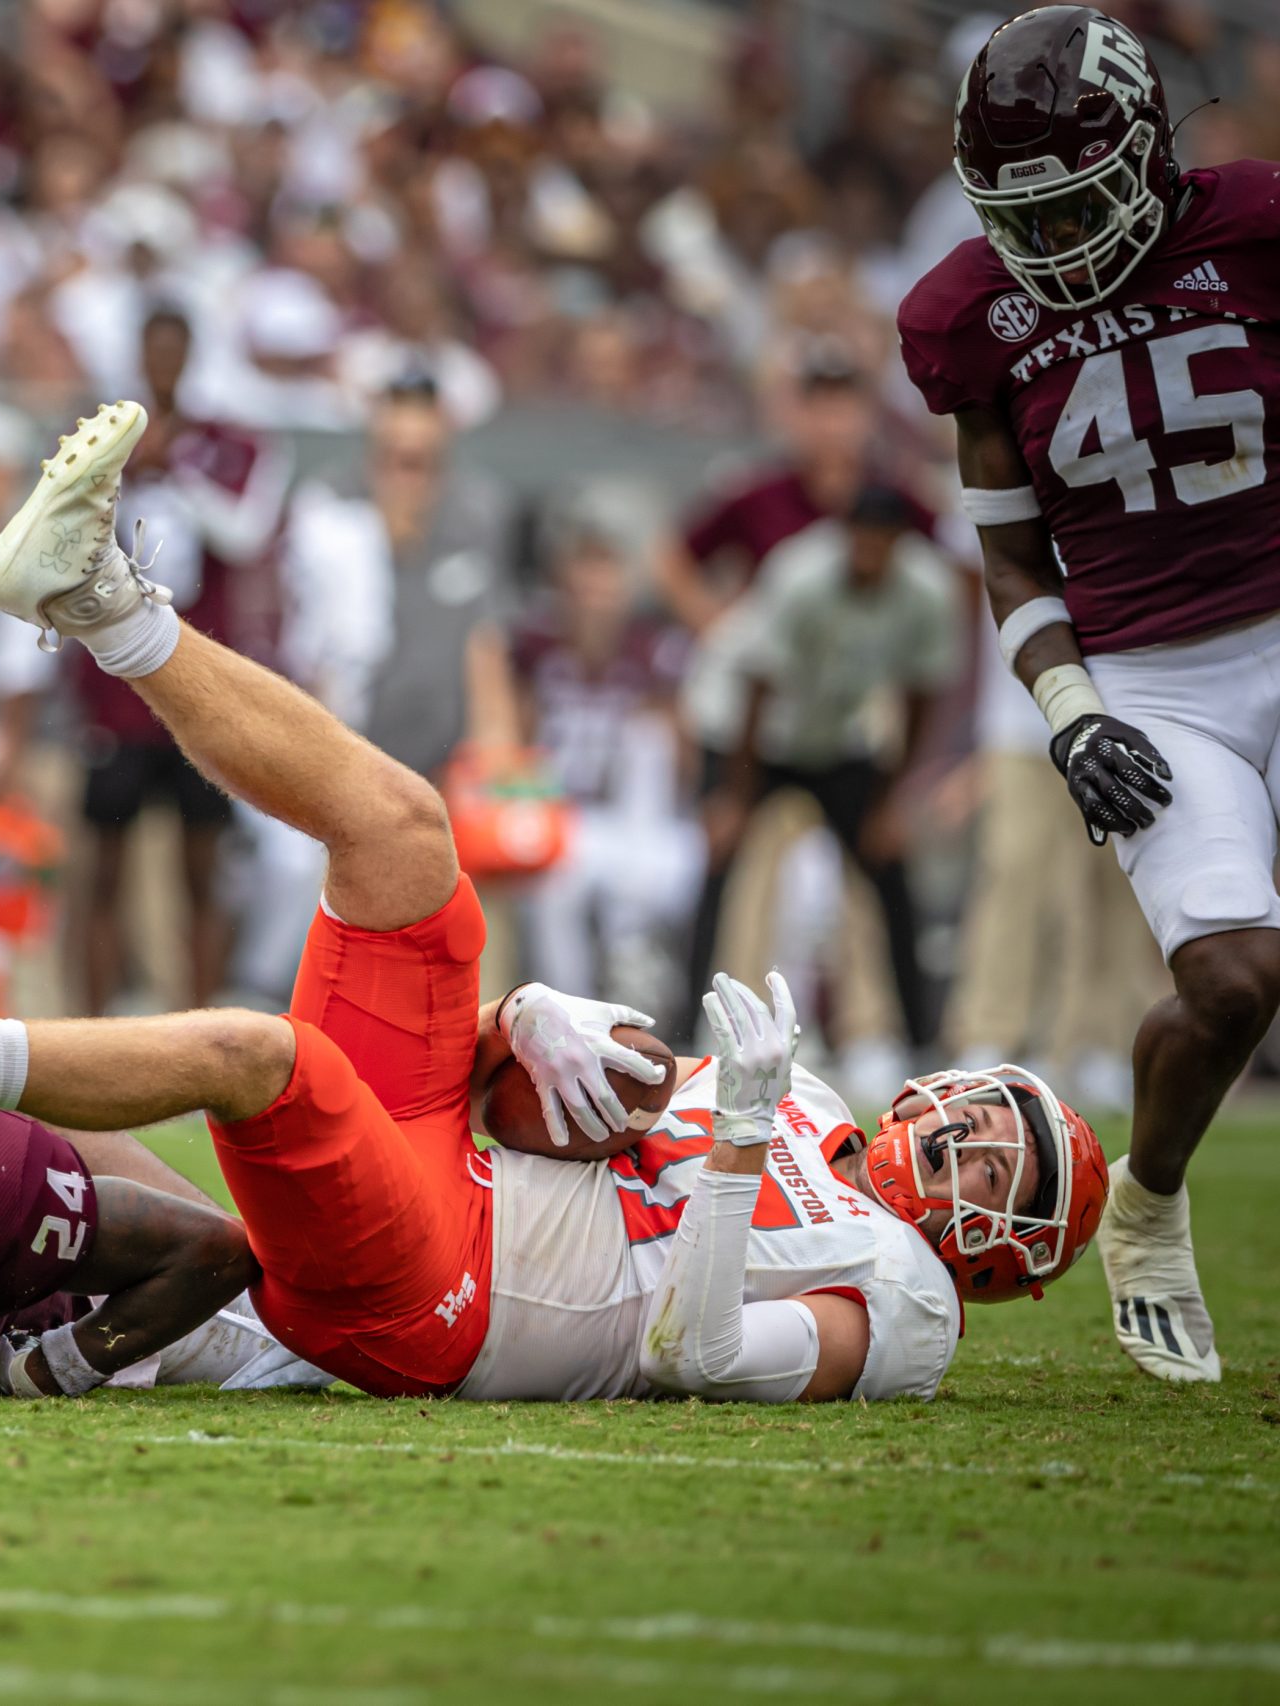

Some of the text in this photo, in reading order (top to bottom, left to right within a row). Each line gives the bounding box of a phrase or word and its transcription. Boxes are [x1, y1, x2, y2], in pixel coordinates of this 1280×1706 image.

[1010, 162, 1048, 179] AGGIES
[992, 296, 1035, 338] SEC
[1173, 279, 1229, 292] adidas
[1010, 304, 1155, 383] TEXAS
[1048, 323, 1267, 513] 45
[31, 1167, 88, 1261] 24
[769, 1136, 834, 1225] HOUSTON
